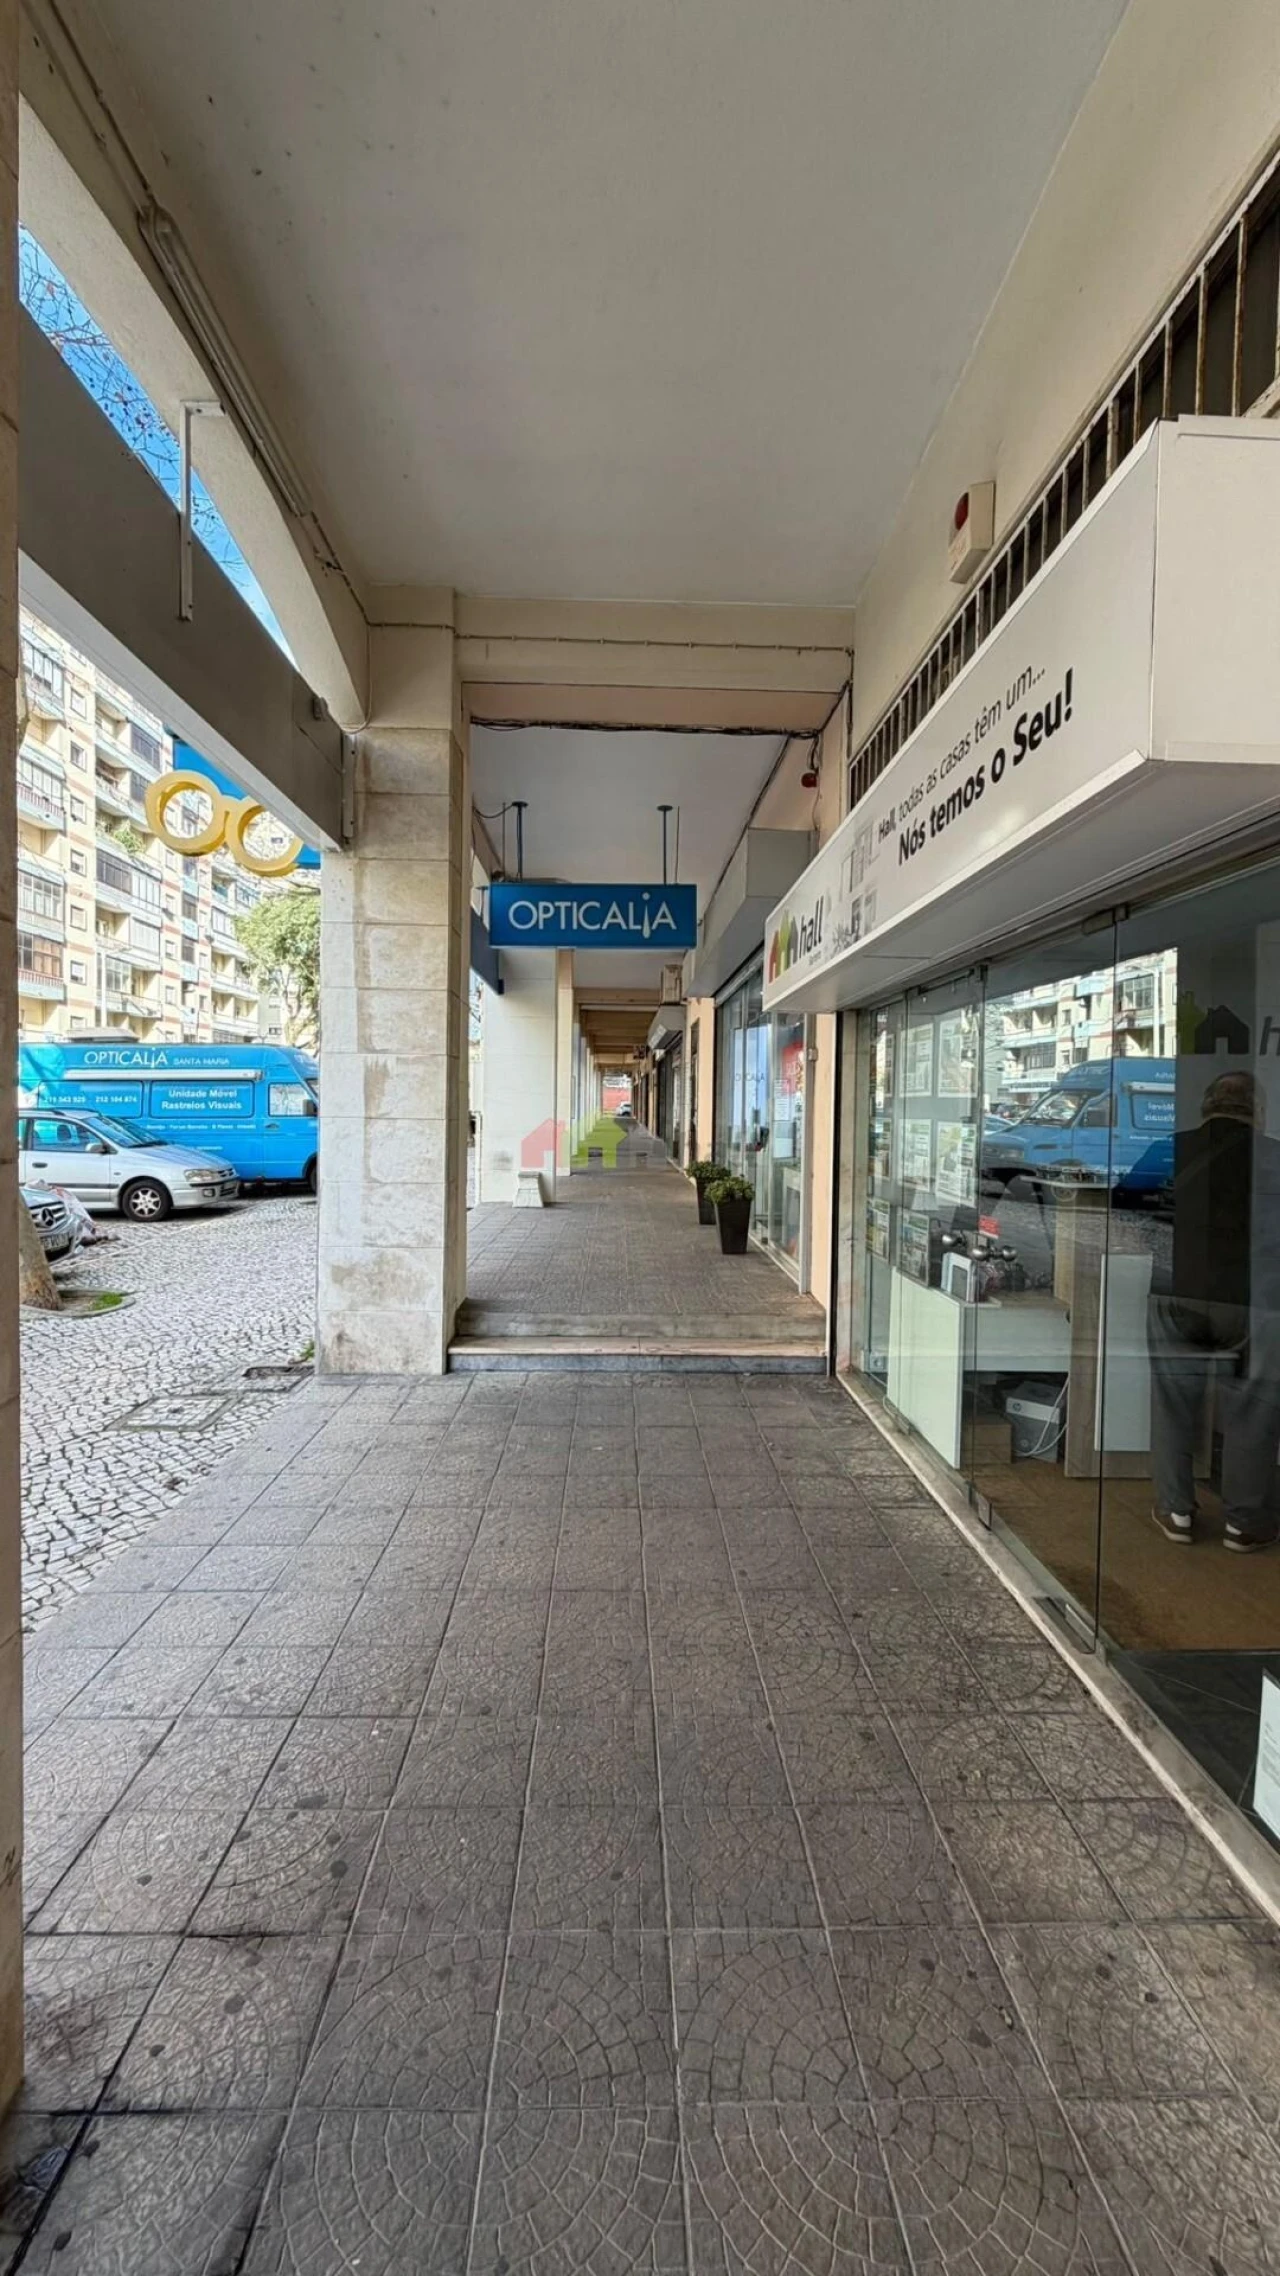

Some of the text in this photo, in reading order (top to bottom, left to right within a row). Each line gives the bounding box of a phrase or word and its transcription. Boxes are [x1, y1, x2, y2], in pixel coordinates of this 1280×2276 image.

[898, 782, 925, 822] todas
[926, 768, 938, 795] as
[939, 731, 972, 780] casas
[974, 700, 1001, 745] têm
[1005, 664, 1046, 711] um...
[898, 666, 1074, 866] Nós temos o Seu!
[798, 895, 824, 959] hall
[173, 1057, 201, 1066] SANTA
[203, 1057, 230, 1066] MARIA
[161, 1099, 243, 1110] Rastreios Visuais
[168, 1087, 238, 1099] Unidade Móvel
